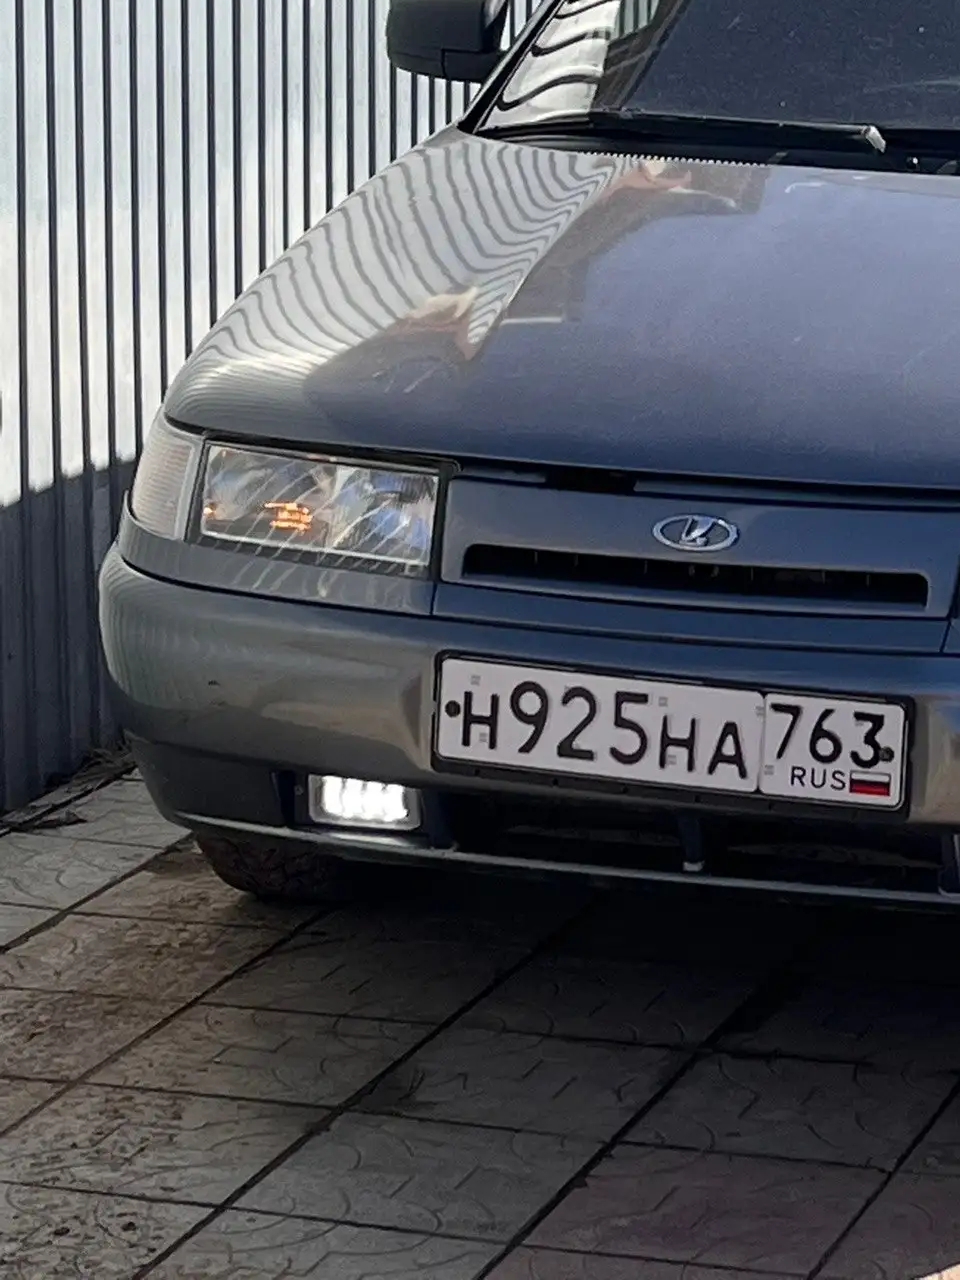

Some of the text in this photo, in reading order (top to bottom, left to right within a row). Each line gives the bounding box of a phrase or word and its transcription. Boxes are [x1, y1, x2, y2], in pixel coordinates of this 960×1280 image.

[461, 680, 886, 779] Н925НА 763
[789, 766, 848, 791] RUS
